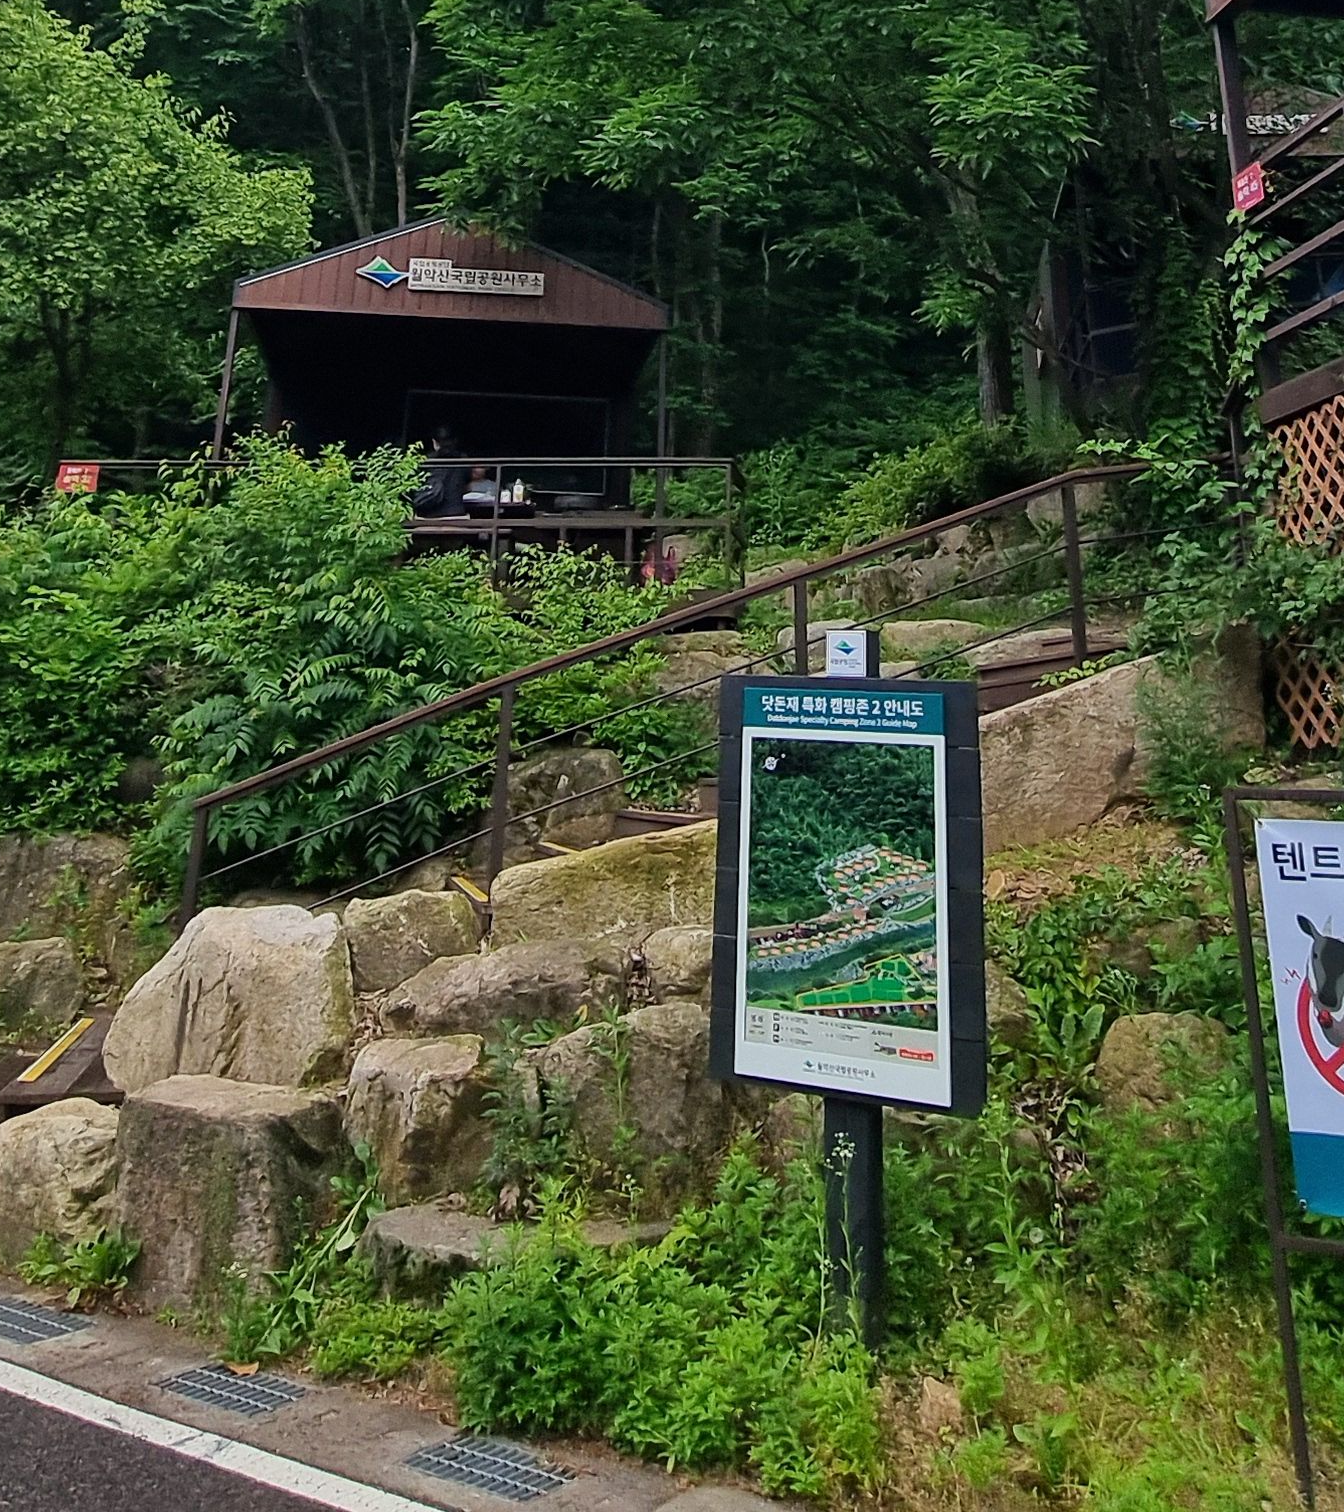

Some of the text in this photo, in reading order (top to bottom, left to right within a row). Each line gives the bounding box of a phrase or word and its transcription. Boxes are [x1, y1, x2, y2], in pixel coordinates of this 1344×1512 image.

[411, 268, 542, 287] 월악산국립공원사무소
[761, 695, 924, 717] 닷돈재 특화 캠핑존 2 안내도
